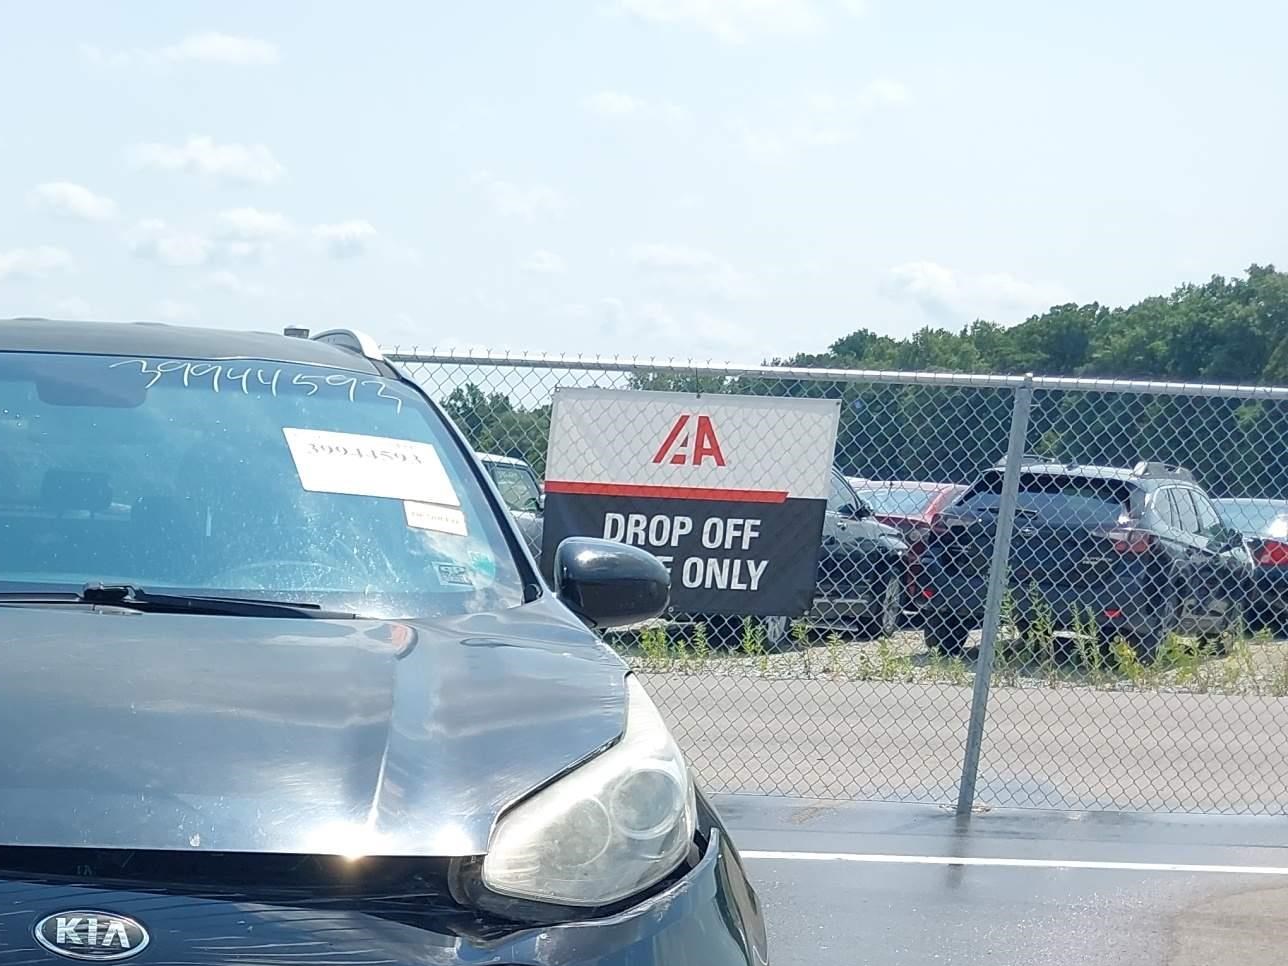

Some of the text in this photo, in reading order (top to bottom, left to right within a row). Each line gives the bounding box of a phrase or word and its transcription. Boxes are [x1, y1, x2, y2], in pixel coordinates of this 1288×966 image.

[109, 359, 401, 415] 39944593
[603, 512, 762, 550] DROP OFF
[682, 556, 769, 591] ONLY
[55, 917, 131, 948] KIA
